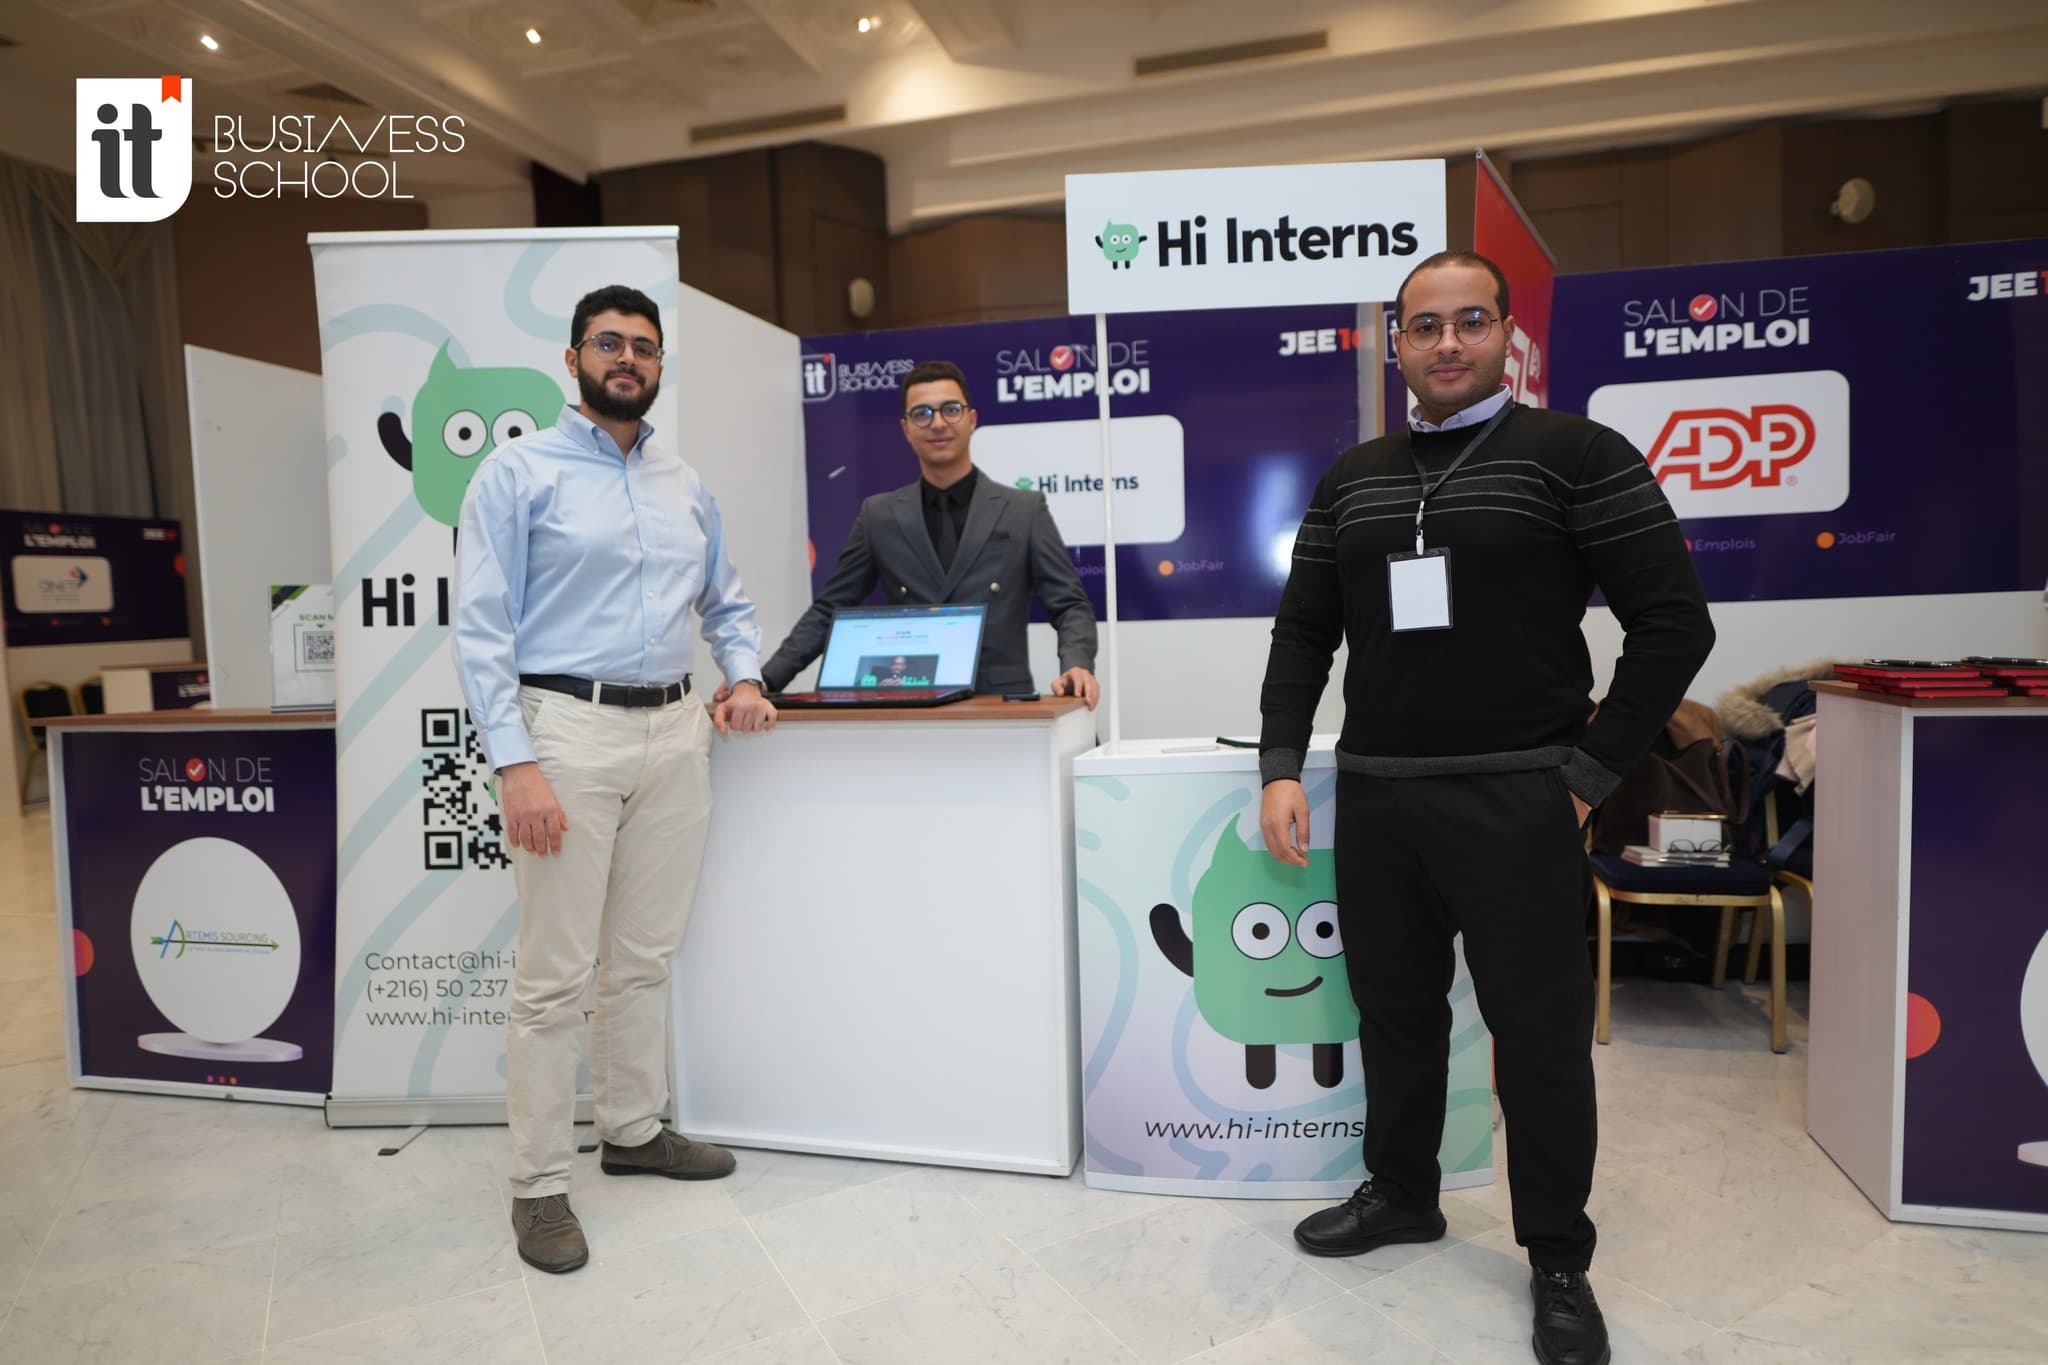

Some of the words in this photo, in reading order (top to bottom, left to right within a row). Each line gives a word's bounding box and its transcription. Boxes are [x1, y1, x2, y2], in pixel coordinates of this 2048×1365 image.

[1157, 214, 1207, 267] Hi
[1226, 214, 1418, 265] Interns
[1623, 290, 1745, 328] SALON
[1760, 286, 1810, 318] DE
[1623, 317, 1810, 359] L'EMPLOI
[1108, 339, 1150, 368] DE
[804, 361, 827, 395] it
[839, 375, 899, 392] SCHOOL
[1646, 403, 1816, 492] ADP
[1038, 474, 1058, 494] Hi
[1064, 473, 1140, 494] Intens
[1694, 536, 1757, 553] Emplois
[1836, 530, 1897, 546] JobFair
[1176, 559, 1225, 572] JobFair
[361, 572, 416, 628] Hi
[298, 612, 326, 621] SCAN
[138, 756, 226, 783] SALON
[235, 756, 273, 783] DE
[140, 784, 276, 813] L'EMPLOI
[366, 978, 429, 1003] (+216)
[435, 979, 464, 998] 50
[469, 978, 509, 999] 237
[1144, 1116, 1365, 1140] www.hi-interns
